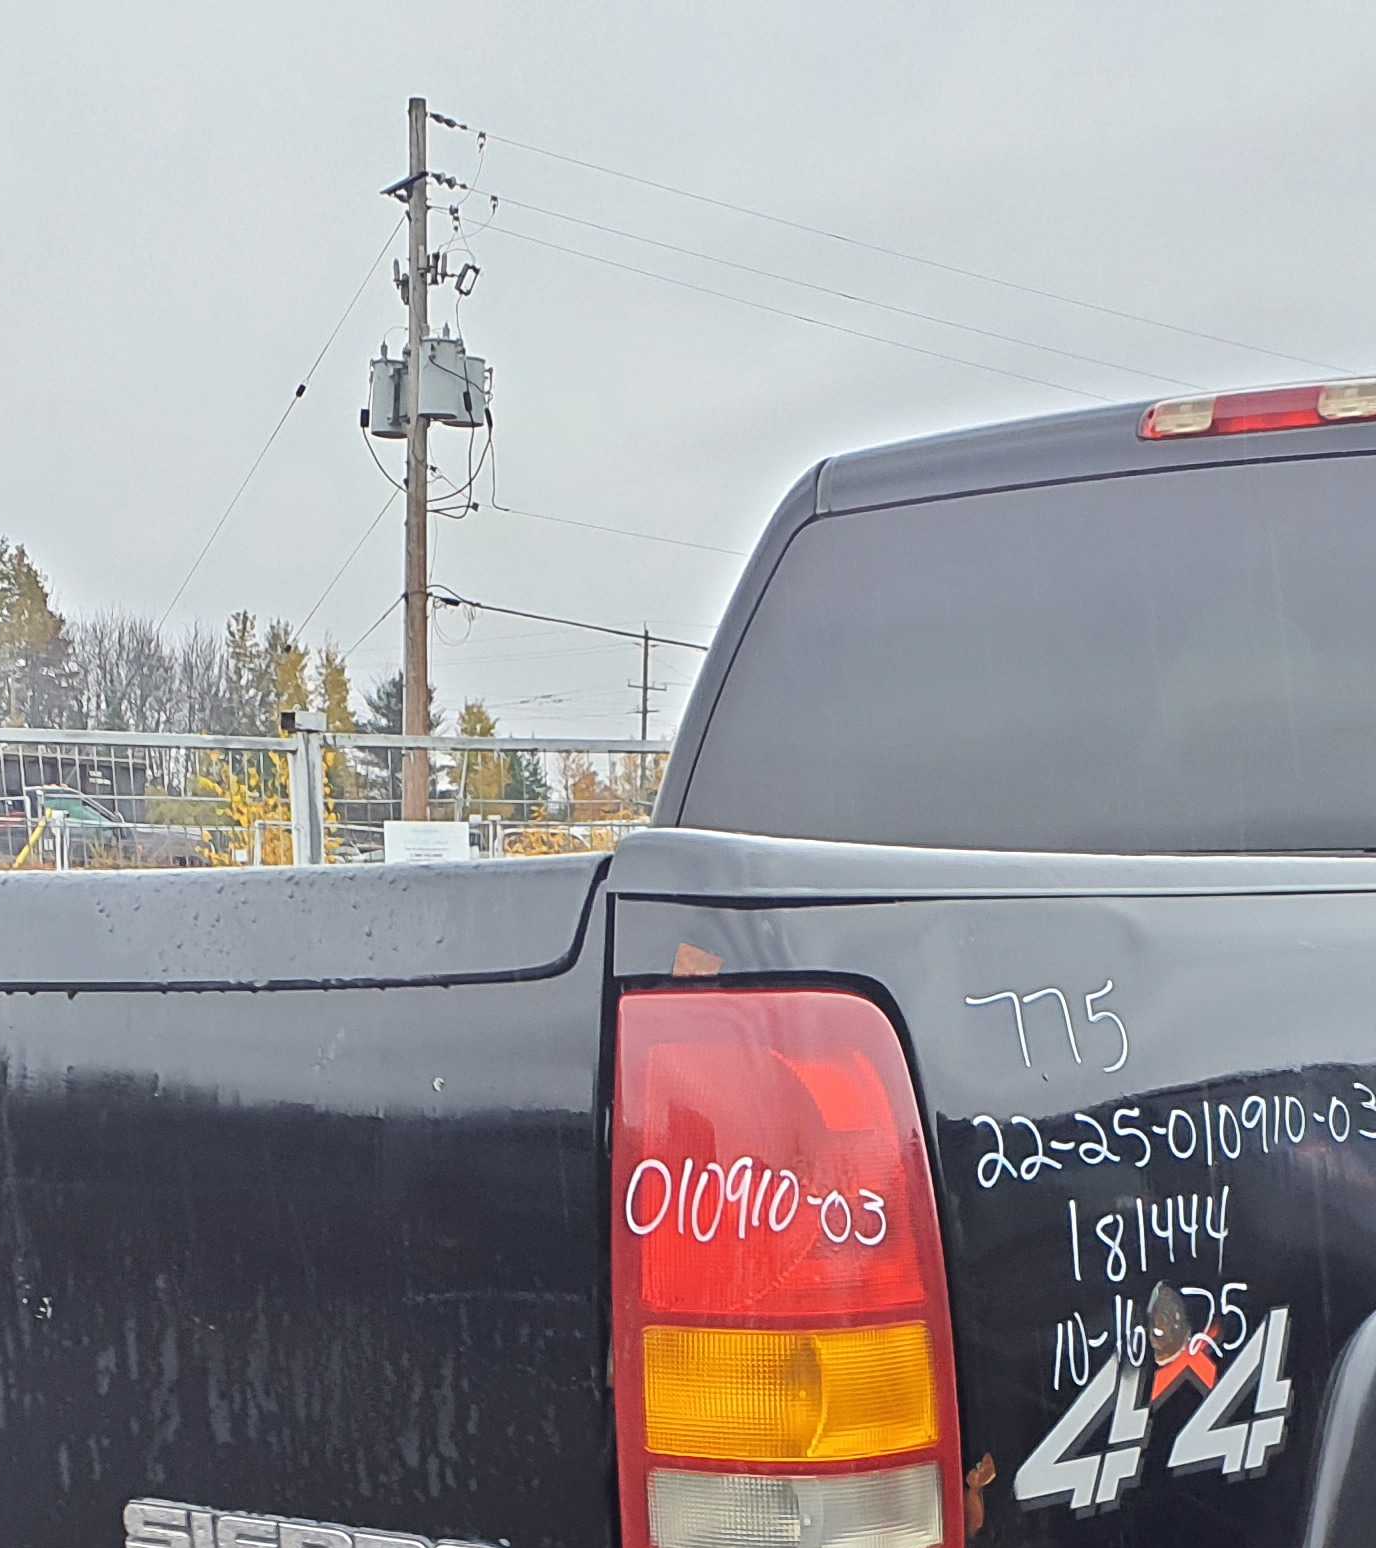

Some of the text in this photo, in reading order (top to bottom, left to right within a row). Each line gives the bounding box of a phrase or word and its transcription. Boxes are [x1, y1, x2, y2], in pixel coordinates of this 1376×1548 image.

[965, 979, 1129, 1073] 775
[625, 1155, 888, 1247] 010910-03
[1068, 1185, 1230, 1283] 181444
